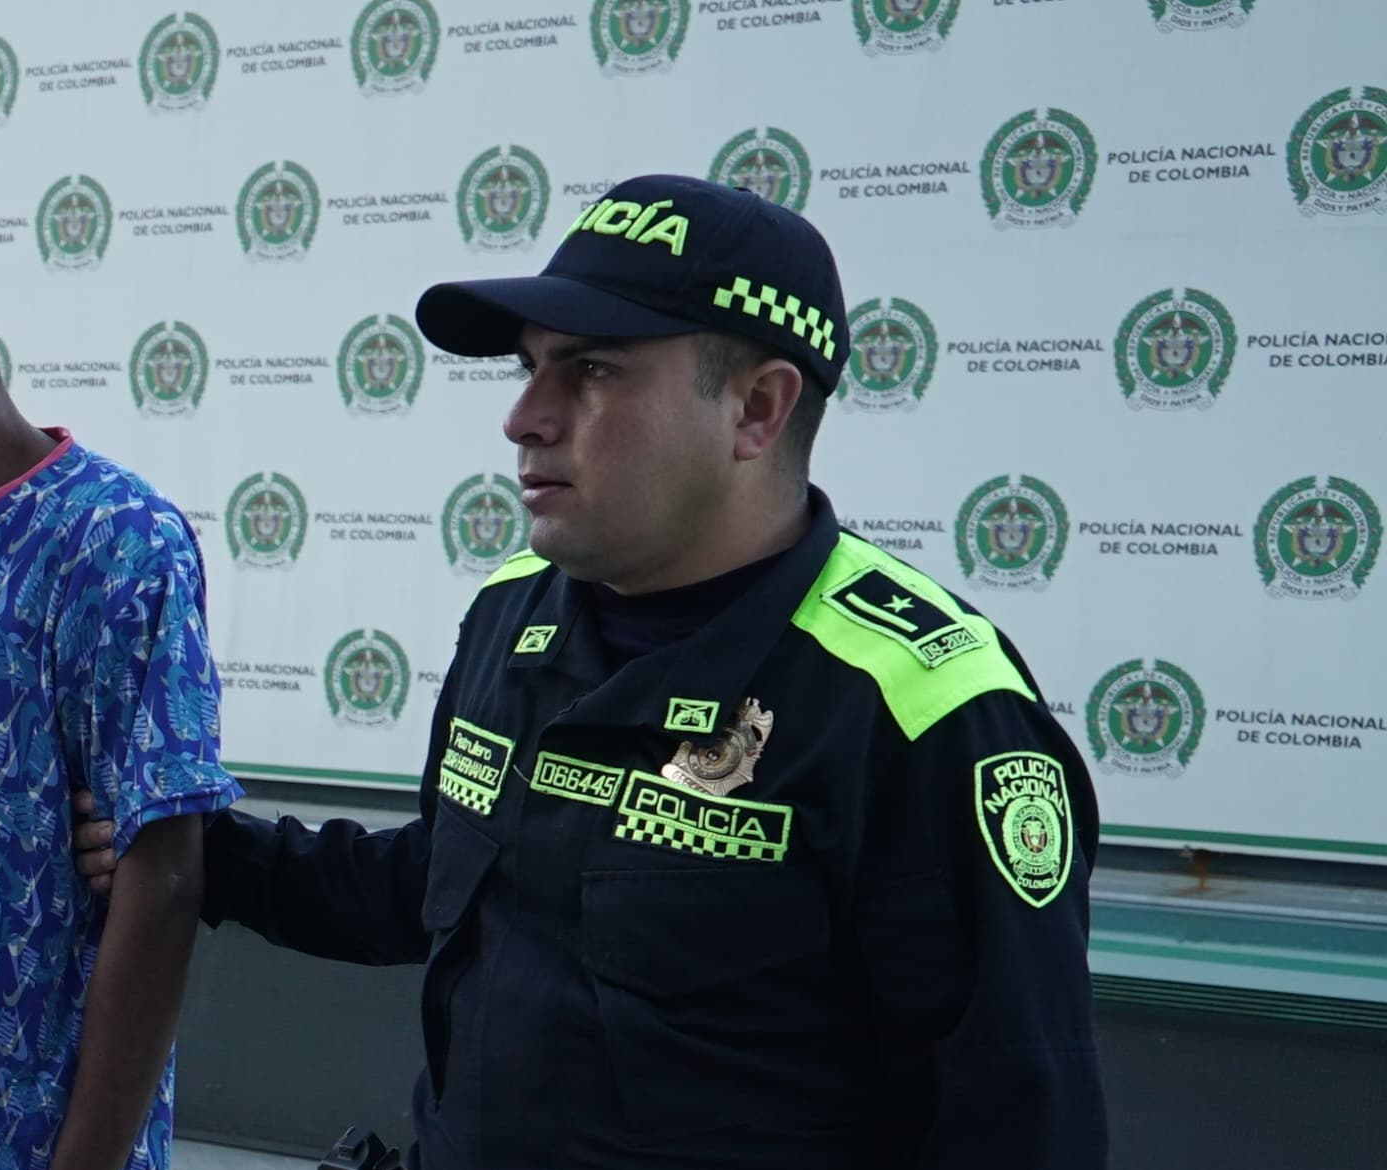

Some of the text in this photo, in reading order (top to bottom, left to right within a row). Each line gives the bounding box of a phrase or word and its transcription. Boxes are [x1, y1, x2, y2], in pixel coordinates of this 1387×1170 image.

[447, 15, 577, 37] POLICÍA NACIONAL
[717, 11, 821, 30] DE COLOMBIA
[277, 37, 345, 54] NACIONAL
[463, 34, 558, 53] DE COLOMBIA
[240, 55, 327, 74] DE COLOMBIA
[1107, 144, 1275, 165] POLICÍA NACIONAL
[819, 161, 971, 181] POLICÍA NACIONAL
[1129, 165, 1250, 183] DE COLOMBIA
[839, 181, 949, 199] DE COLOMBIA
[380, 192, 451, 206] NACIONAL
[342, 210, 432, 225] DE COLOMBIA
[947, 339, 1105, 353] POLICÍA NACIONAL
[1247, 331, 1387, 348] POLICÍA NACIO
[265, 357, 331, 368] NACIONAL
[966, 359, 1081, 372] DE COLOMBIA
[1269, 352, 1387, 368] DE COLOMBI
[229, 374, 313, 385] DE COLOMBIA
[367, 514, 435, 524] NACIONAL
[863, 520, 946, 533] NACIONAL
[330, 529, 417, 540] DE COLOMBIA
[1079, 520, 1243, 536] POLICÍA NACIONAL
[1099, 542, 1219, 555] DE COLOMBIA
[237, 678, 300, 691] COLOMBIA
[1215, 708, 1387, 731] POLICÍA NACIONAL
[1237, 730, 1361, 749] DE COLOMBIA
[540, 761, 618, 798] 066445
[993, 759, 1058, 788] POLICÍA
[984, 779, 1065, 817] NACIONAL
[635, 787, 767, 841] POLICÍA
